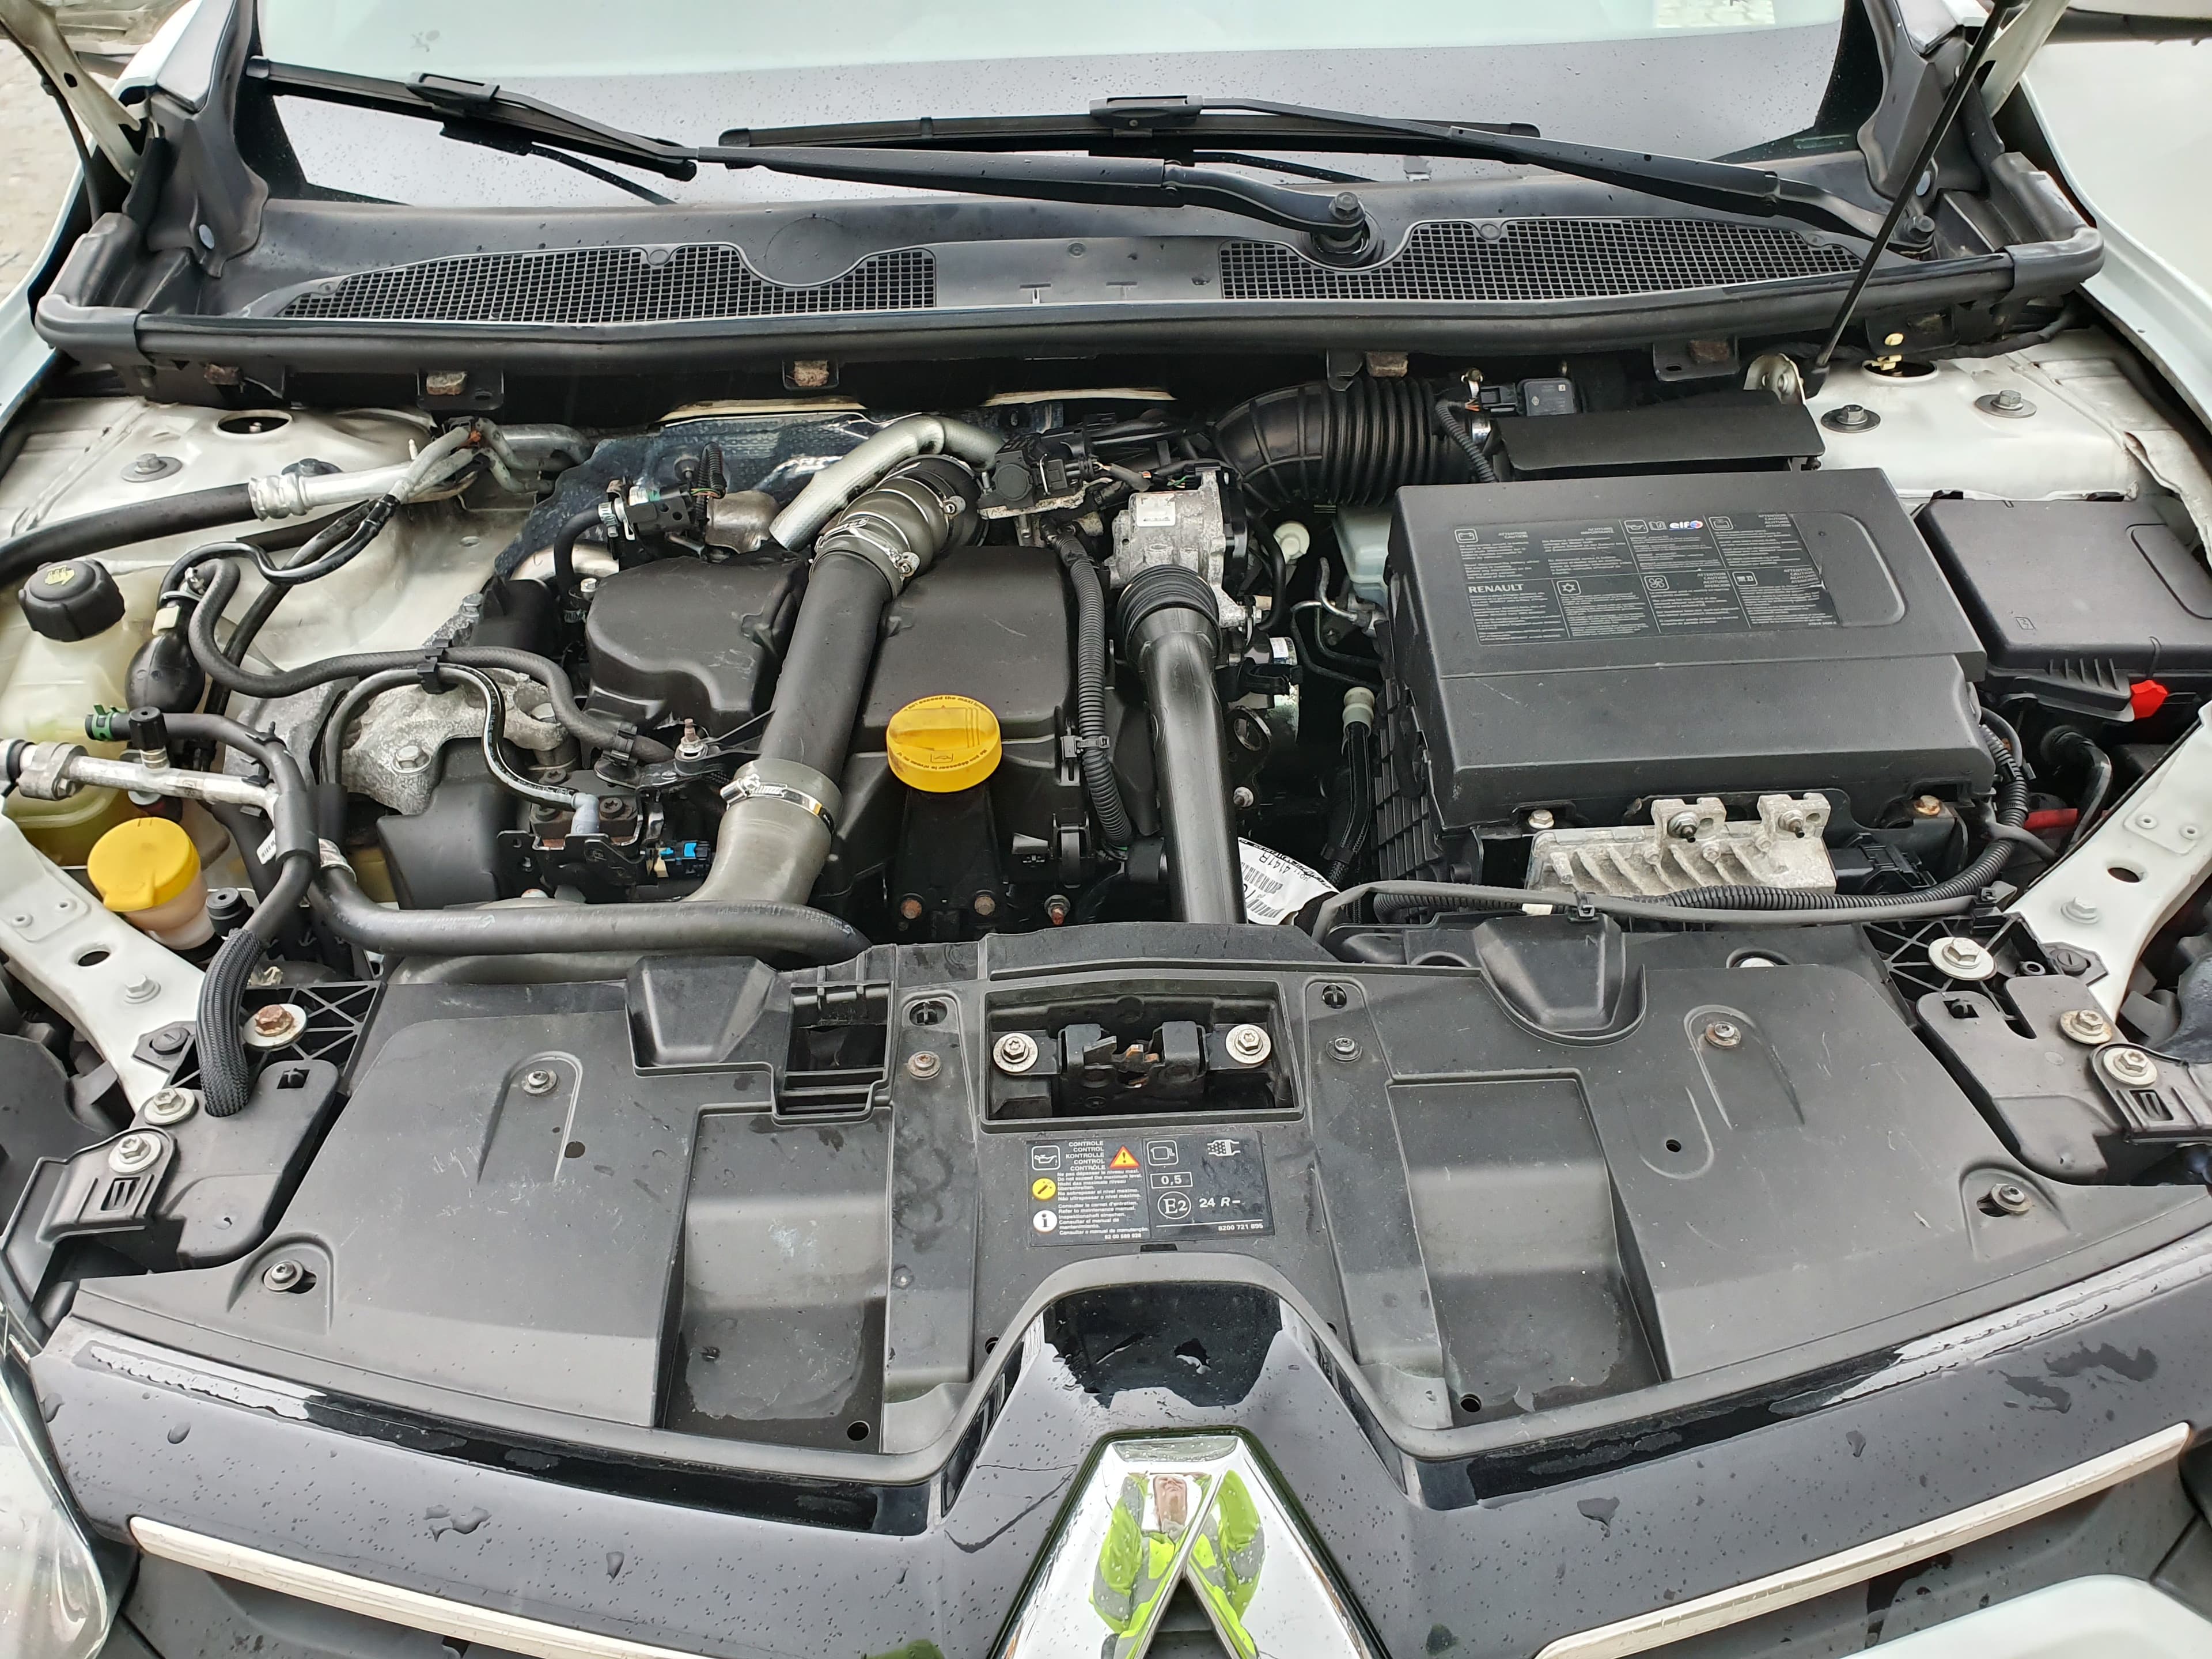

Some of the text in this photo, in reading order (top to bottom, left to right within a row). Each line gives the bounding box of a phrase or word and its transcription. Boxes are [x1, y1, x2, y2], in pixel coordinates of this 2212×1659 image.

[1669, 521, 1690, 529] elf
[1468, 584, 1524, 593] RENAULT
[919, 696, 943, 704] exceed
[1161, 1175, 1182, 1185] 0,5
[1163, 1198, 1188, 1214] E2
[1199, 1198, 1215, 1208] 24
